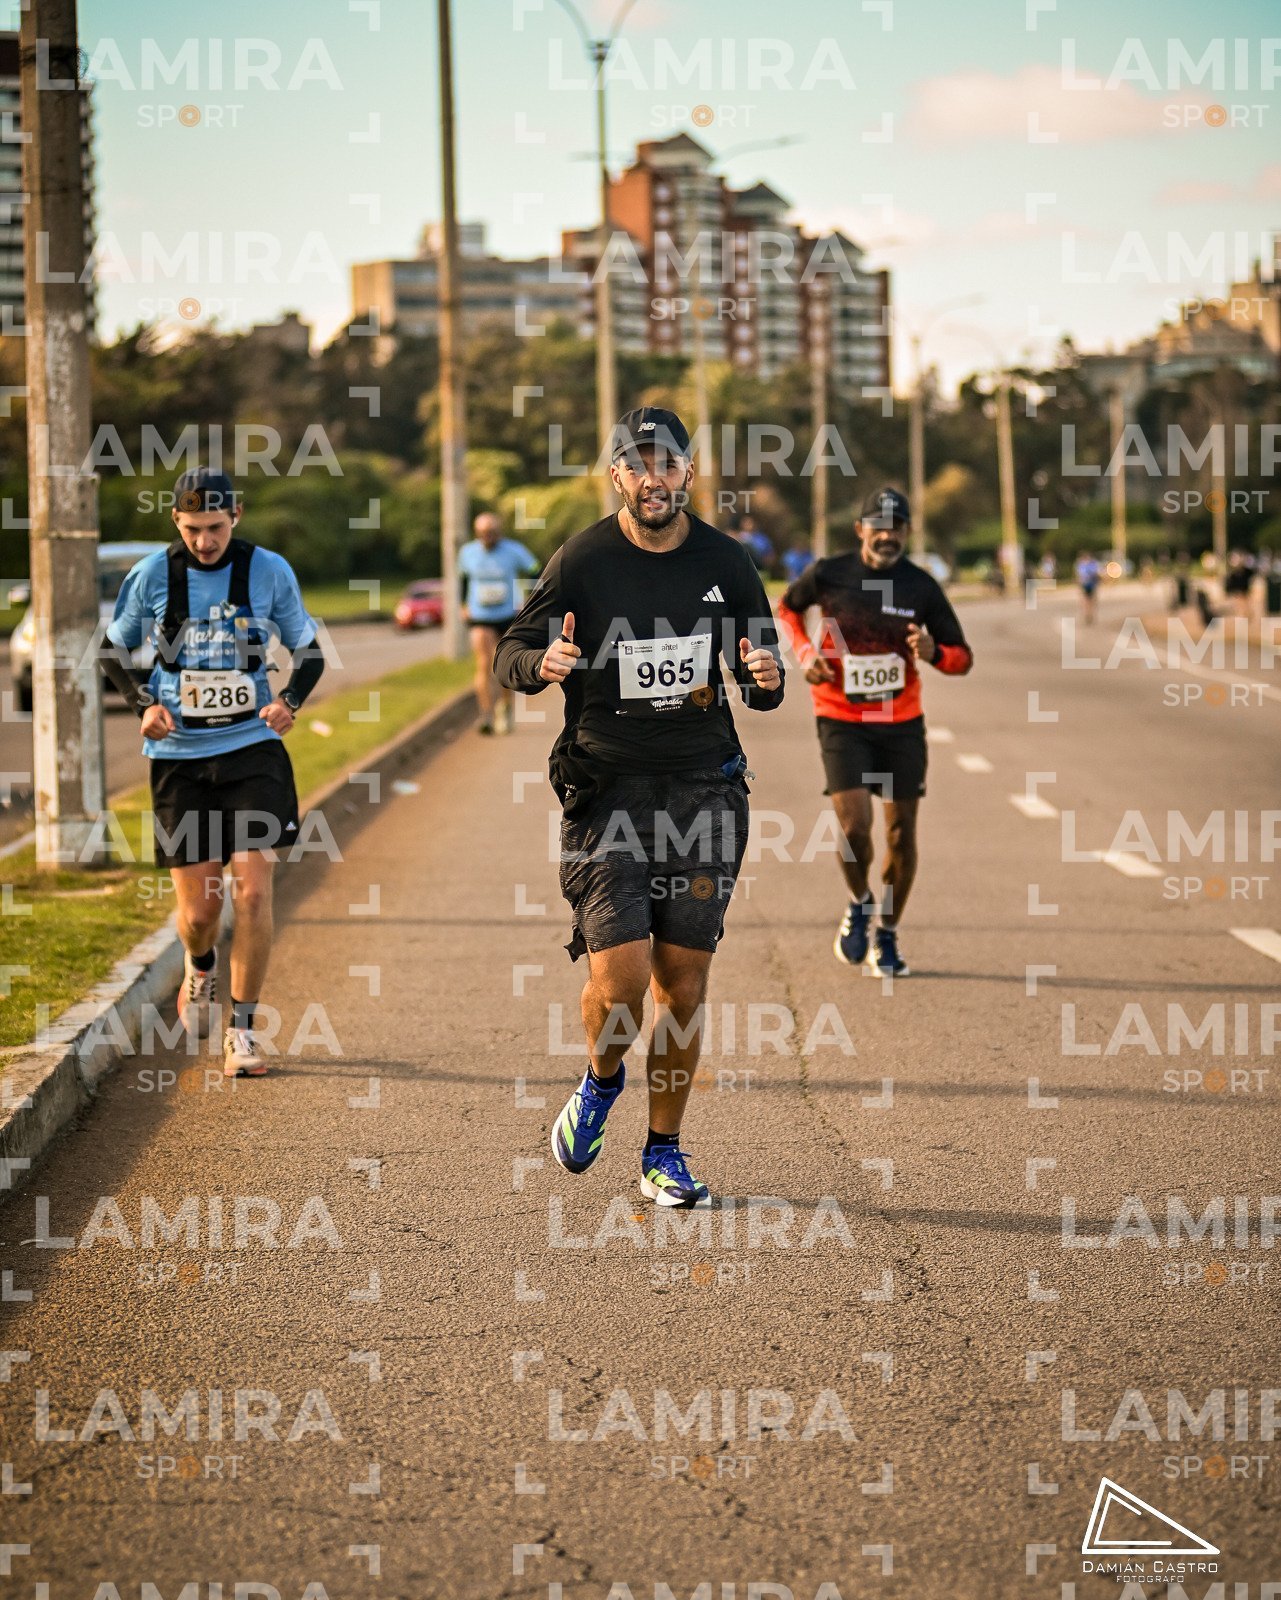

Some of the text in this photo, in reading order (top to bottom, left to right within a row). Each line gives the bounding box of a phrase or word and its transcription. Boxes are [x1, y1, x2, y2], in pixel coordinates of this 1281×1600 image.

[637, 657, 694, 689] 965
[851, 667, 899, 687] 1508
[188, 686, 249, 709] 1286
